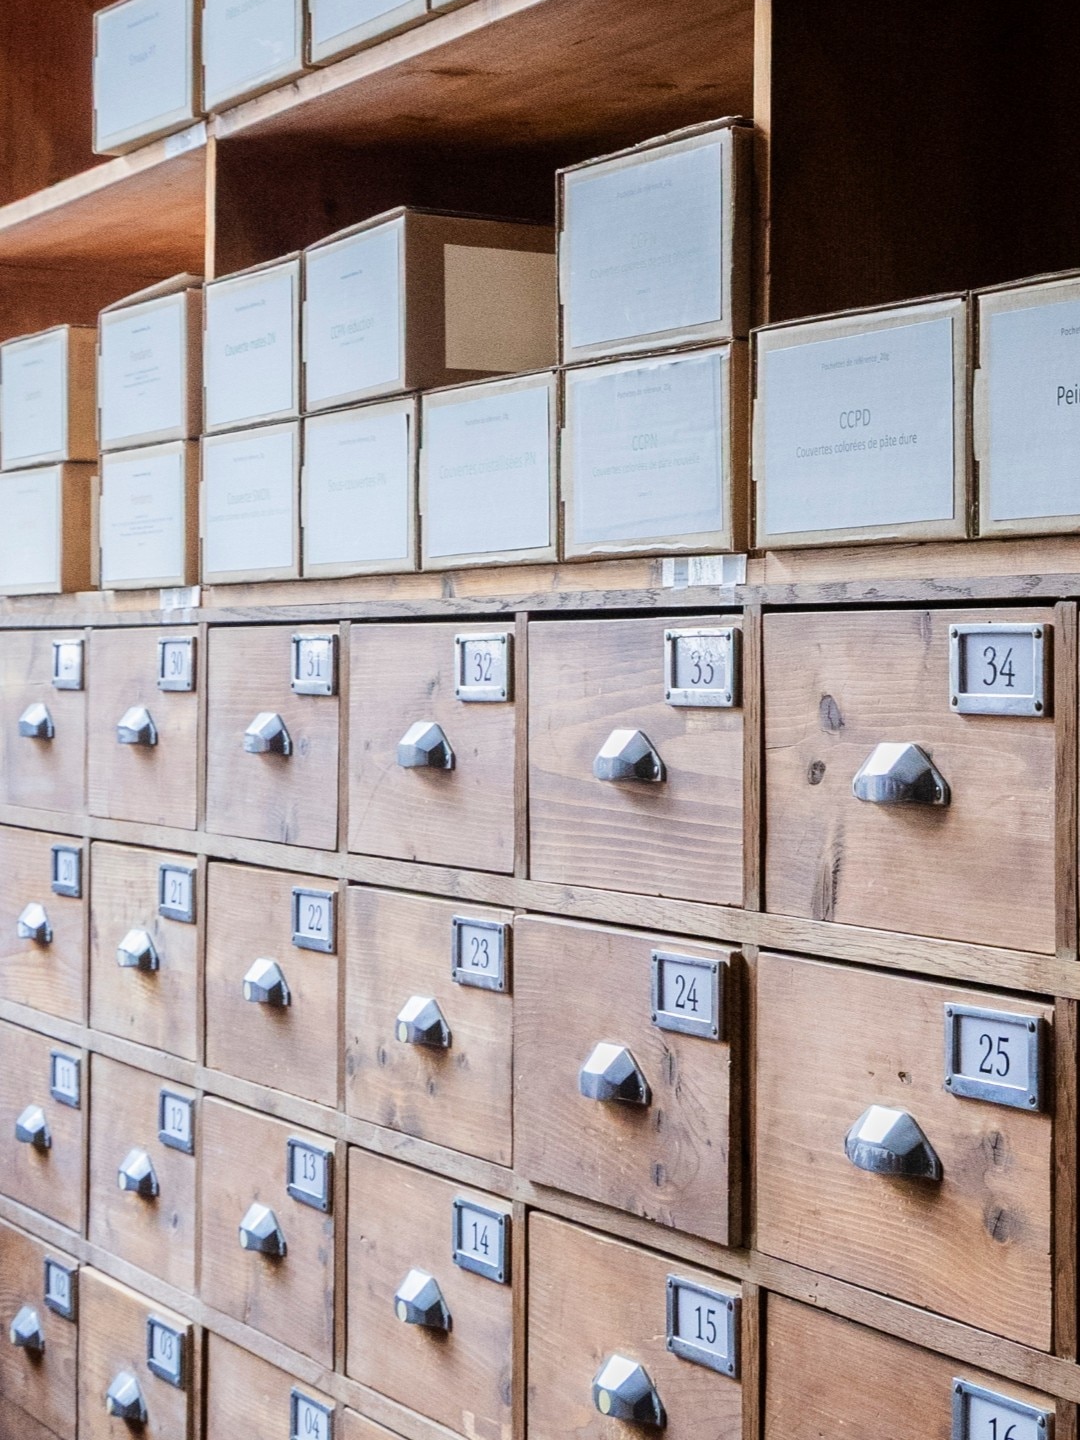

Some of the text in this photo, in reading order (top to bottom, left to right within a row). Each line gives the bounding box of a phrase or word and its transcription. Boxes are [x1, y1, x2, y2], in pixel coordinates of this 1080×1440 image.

[839, 408, 871, 430] CCPD
[867, 437, 878, 450] de
[879, 433, 897, 450] pâte
[898, 432, 918, 445] dure
[306, 651, 322, 678] 31
[474, 650, 493, 683] 32
[691, 649, 715, 685] 33
[983, 646, 1016, 688] 34
[170, 880, 183, 905] 21
[307, 904, 323, 932] 22
[471, 936, 490, 969] 23
[675, 974, 699, 1013] 24
[979, 1033, 1010, 1077] 25
[171, 1105, 183, 1132] 12
[301, 1154, 317, 1182] 13
[471, 1221, 490, 1256] 14
[694, 1304, 717, 1345] 15
[158, 1330, 173, 1361] 03
[304, 1407, 321, 1439] 04
